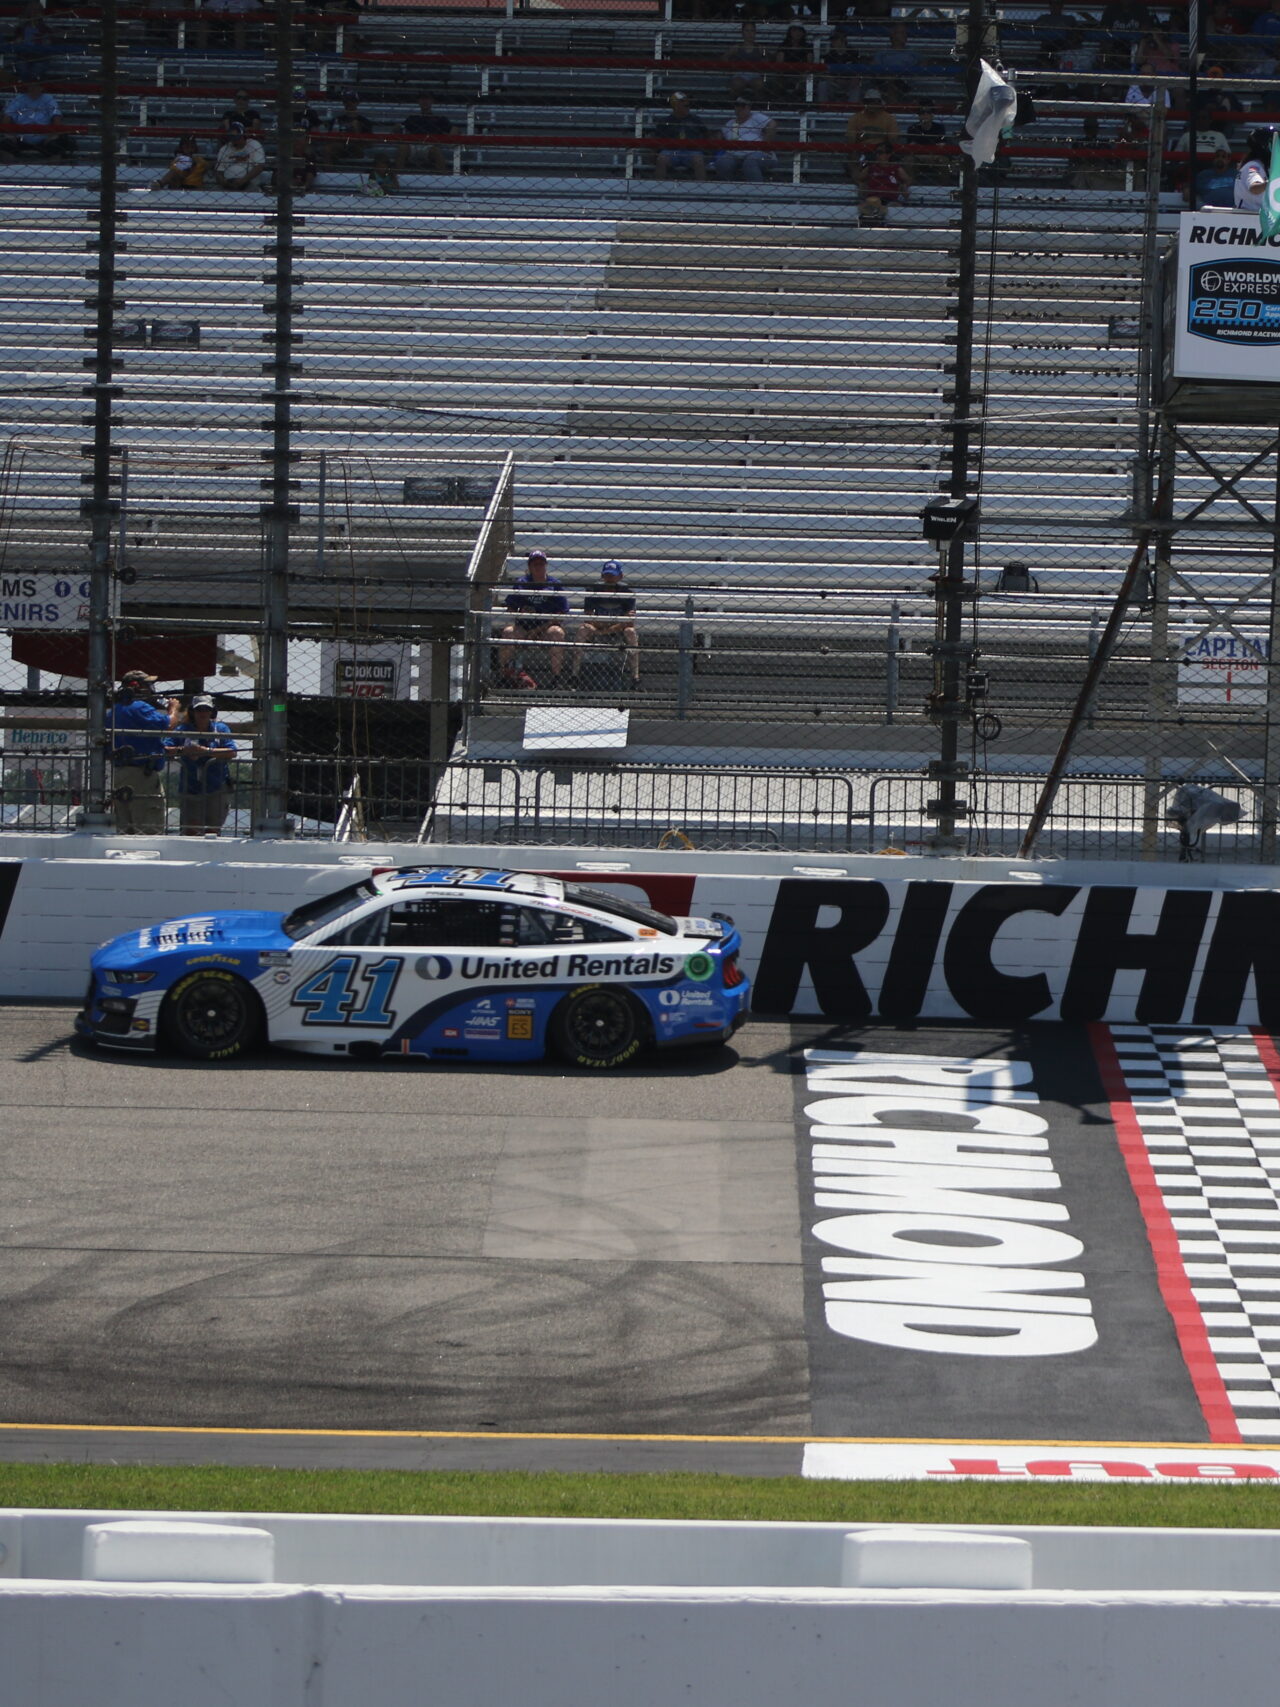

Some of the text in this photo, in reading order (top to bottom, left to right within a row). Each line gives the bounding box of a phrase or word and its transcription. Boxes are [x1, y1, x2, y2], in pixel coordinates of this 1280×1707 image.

[1223, 283, 1278, 295] EXPRESS
[1193, 297, 1264, 321] 250
[1216, 329, 1253, 337] RICHMOND
[0, 602, 60, 622] NIRS
[1201, 658, 1259, 671] SECTION
[345, 666, 393, 679] COOK OUT
[12, 729, 68, 744] Henrico
[460, 953, 675, 979] United Rentals
[290, 954, 405, 1029] 41
[511, 1022, 529, 1035] ES
[803, 1048, 1099, 1357] RICHMOND
